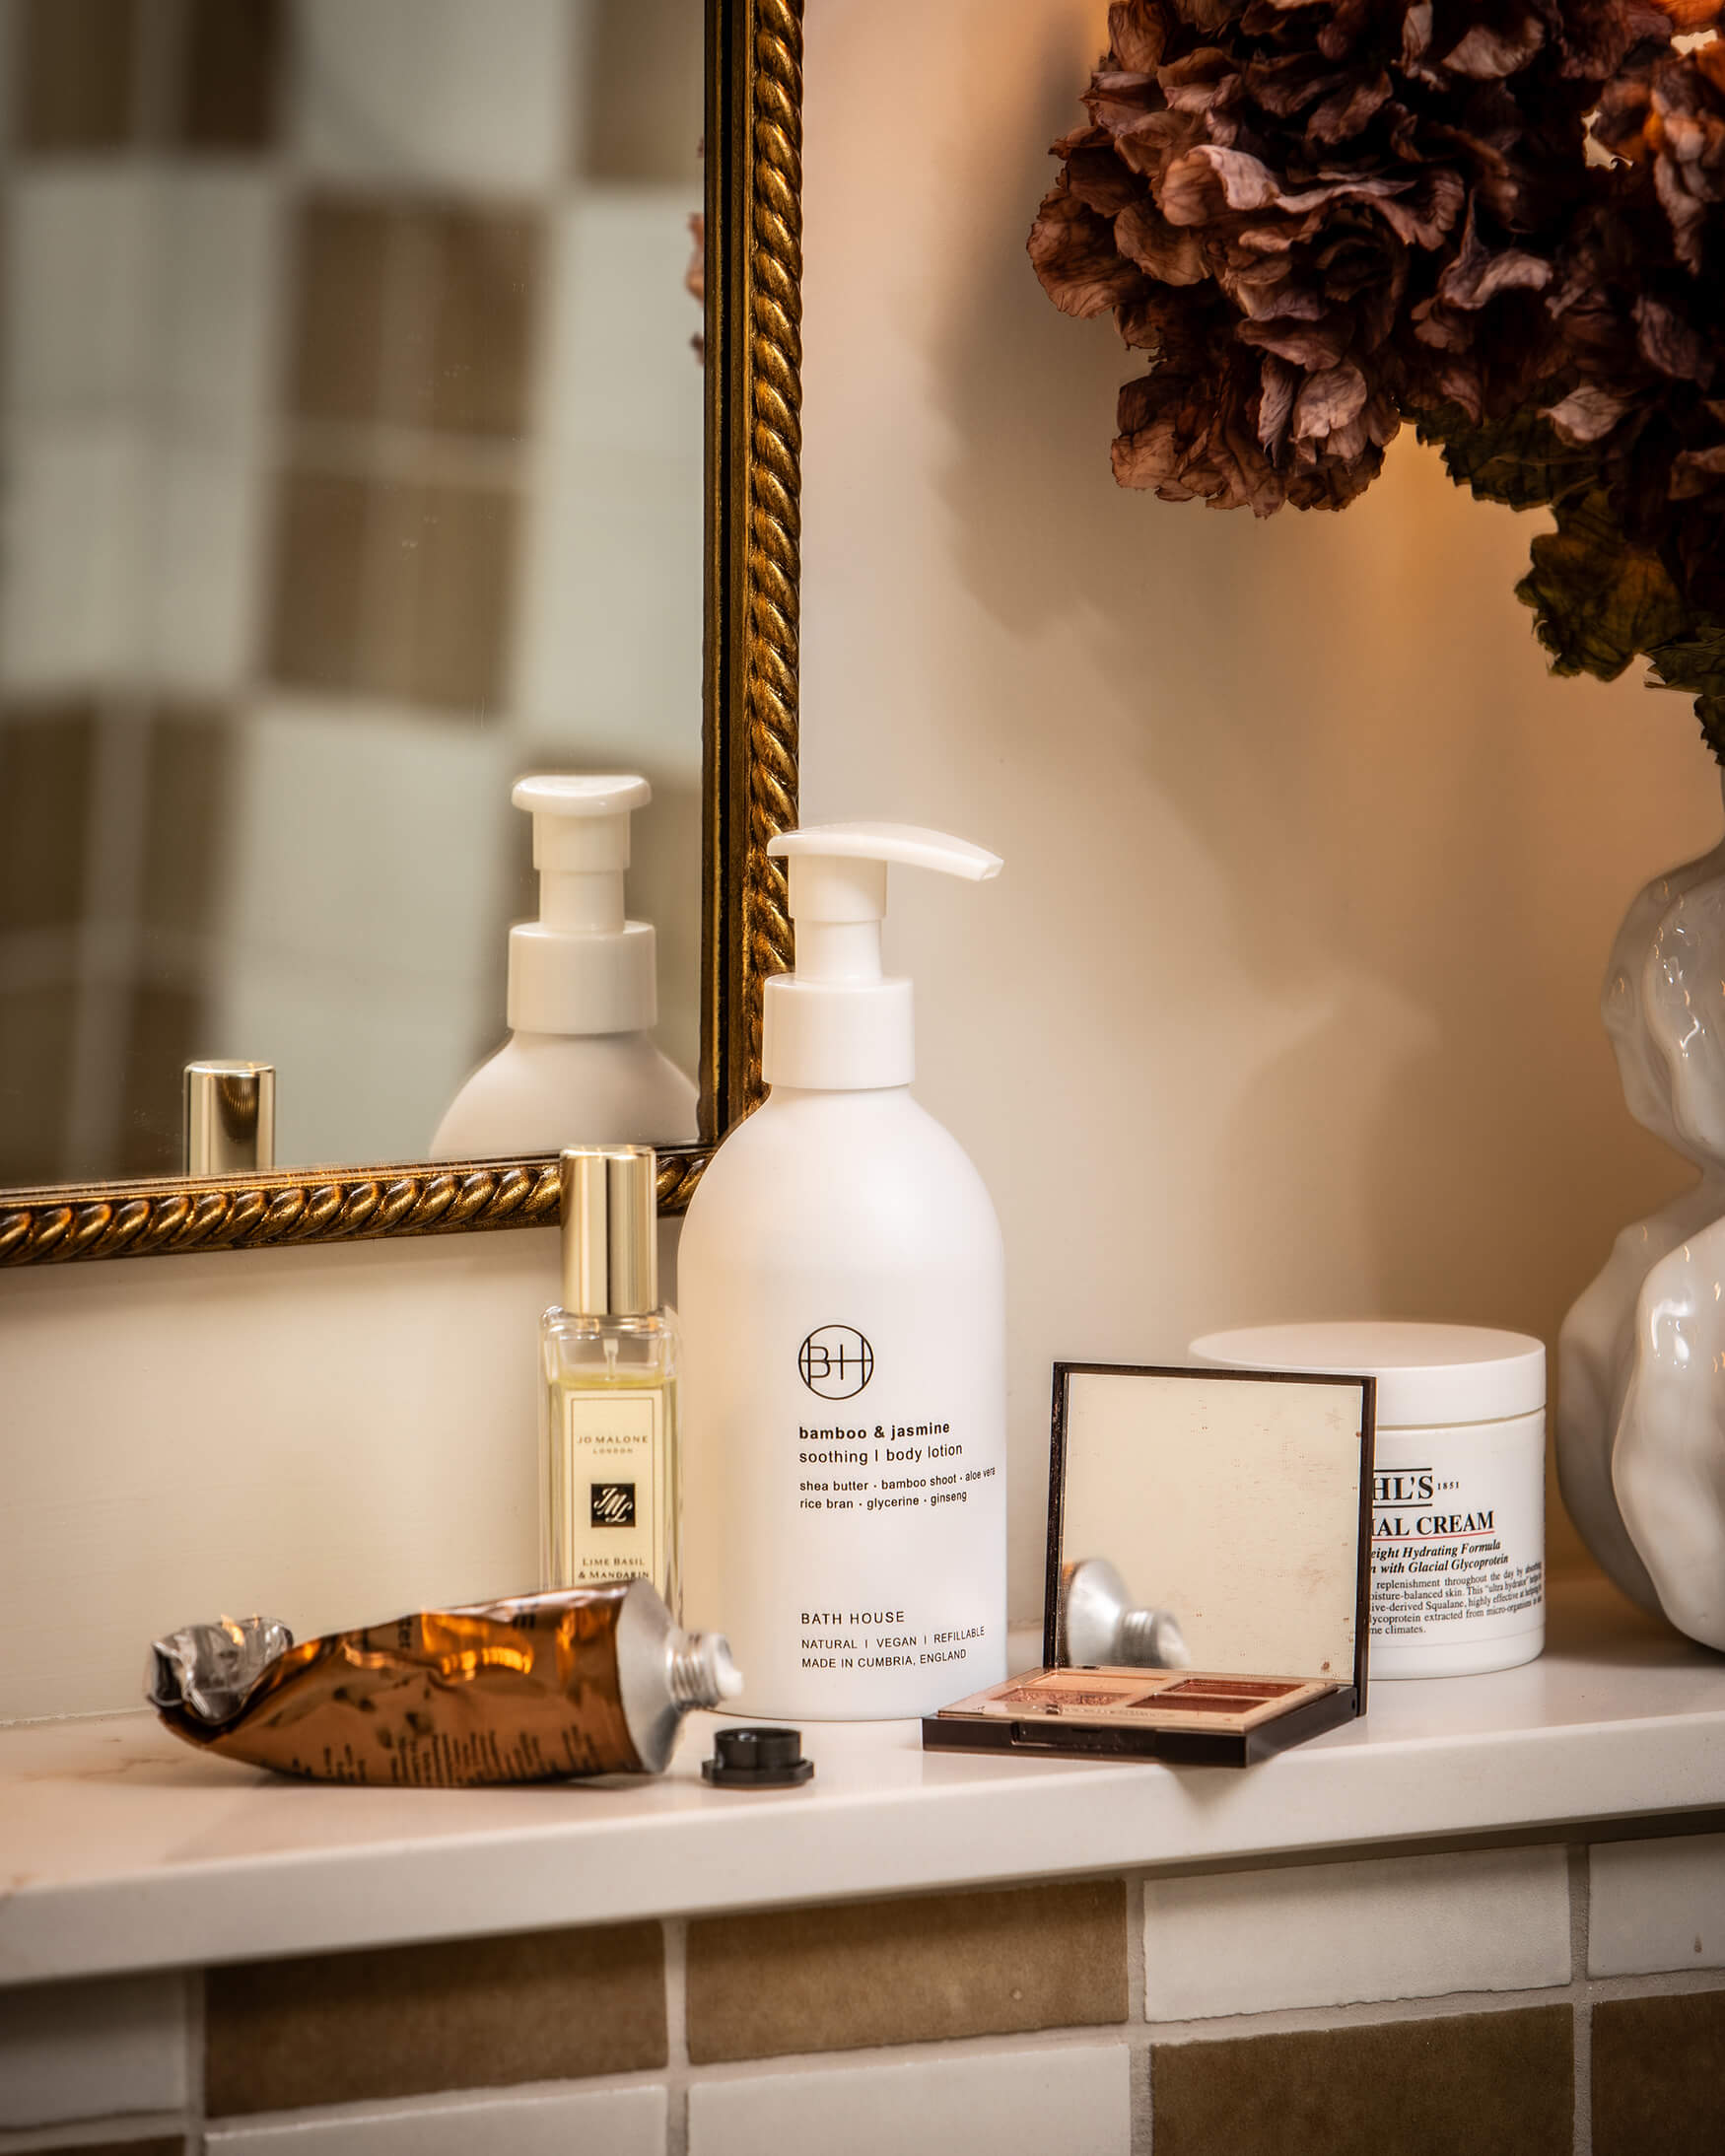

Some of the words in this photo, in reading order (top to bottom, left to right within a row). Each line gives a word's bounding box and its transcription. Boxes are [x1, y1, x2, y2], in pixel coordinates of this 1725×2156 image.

[577, 1434, 591, 1443] JO
[595, 1434, 649, 1443] MALONE
[799, 1426, 867, 1439] bamboo
[873, 1425, 885, 1438] &
[891, 1422, 950, 1441] jasmine
[799, 1449, 868, 1466] soothing
[886, 1446, 923, 1463] body
[928, 1443, 963, 1459] lotion
[799, 1480, 829, 1491] shea
[833, 1480, 868, 1491] butter
[881, 1478, 927, 1490] bamboo
[930, 1473, 957, 1487] shoot
[965, 1470, 982, 1482] aloe
[1437, 1481, 1459, 1491] 1851
[799, 1497, 822, 1509] rice
[826, 1497, 854, 1509] bran
[866, 1495, 920, 1511] glycerine
[931, 1491, 967, 1507] ginseng
[1416, 1510, 1494, 1535] CREAM
[1402, 1545, 1458, 1561] Hydrating
[1461, 1539, 1501, 1555] Formula
[583, 1558, 610, 1566] LIME
[613, 1557, 646, 1566] BASIL
[1380, 1562, 1405, 1573] with
[1408, 1560, 1449, 1573] Glacial
[1451, 1553, 1509, 1572] Glycoprotein
[1376, 1577, 1440, 1591] replenishment
[1444, 1574, 1487, 1587] throughout
[1467, 1584, 1484, 1596] This
[801, 1613, 842, 1625] BATH
[850, 1611, 905, 1625] HOUSE
[1423, 1609, 1463, 1623] extracted
[801, 1638, 858, 1649] NATURAL
[876, 1636, 917, 1648] VEGAN
[933, 1626, 985, 1643] REFILLABLE
[801, 1658, 836, 1668] MADE
[841, 1658, 854, 1668] IN
[858, 1655, 916, 1668] CUMBRIA,
[920, 1648, 967, 1664] ENGLAND
